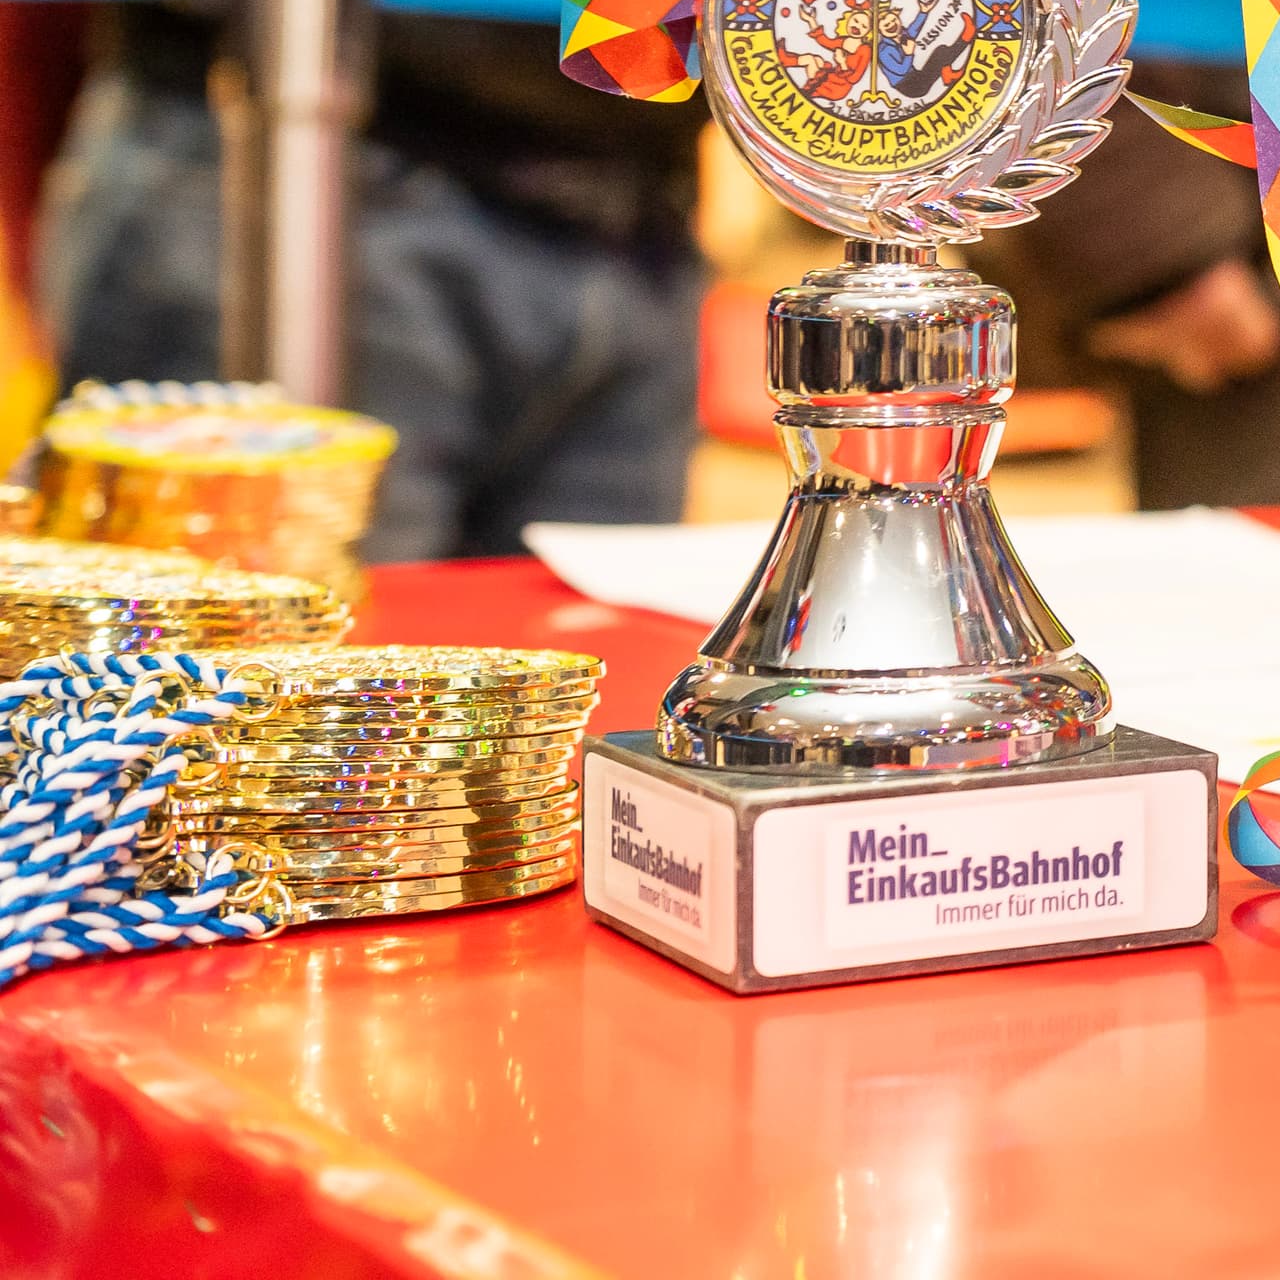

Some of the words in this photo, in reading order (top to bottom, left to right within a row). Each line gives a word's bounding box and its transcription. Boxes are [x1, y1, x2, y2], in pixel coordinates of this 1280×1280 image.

[916, 11, 955, 50] SESSION
[750, 90, 801, 143] Mein
[752, 49, 804, 116] KÖLN
[802, 49, 994, 150] HAUPTBAHNHOF
[611, 786, 643, 833] Mein_
[847, 824, 948, 865] Mein_
[847, 840, 1123, 905] EinkaufsBahnhof
[936, 901, 1003, 925] Immer
[1007, 894, 1036, 918] für
[1041, 888, 1089, 915] mich
[1094, 884, 1124, 908] da.
